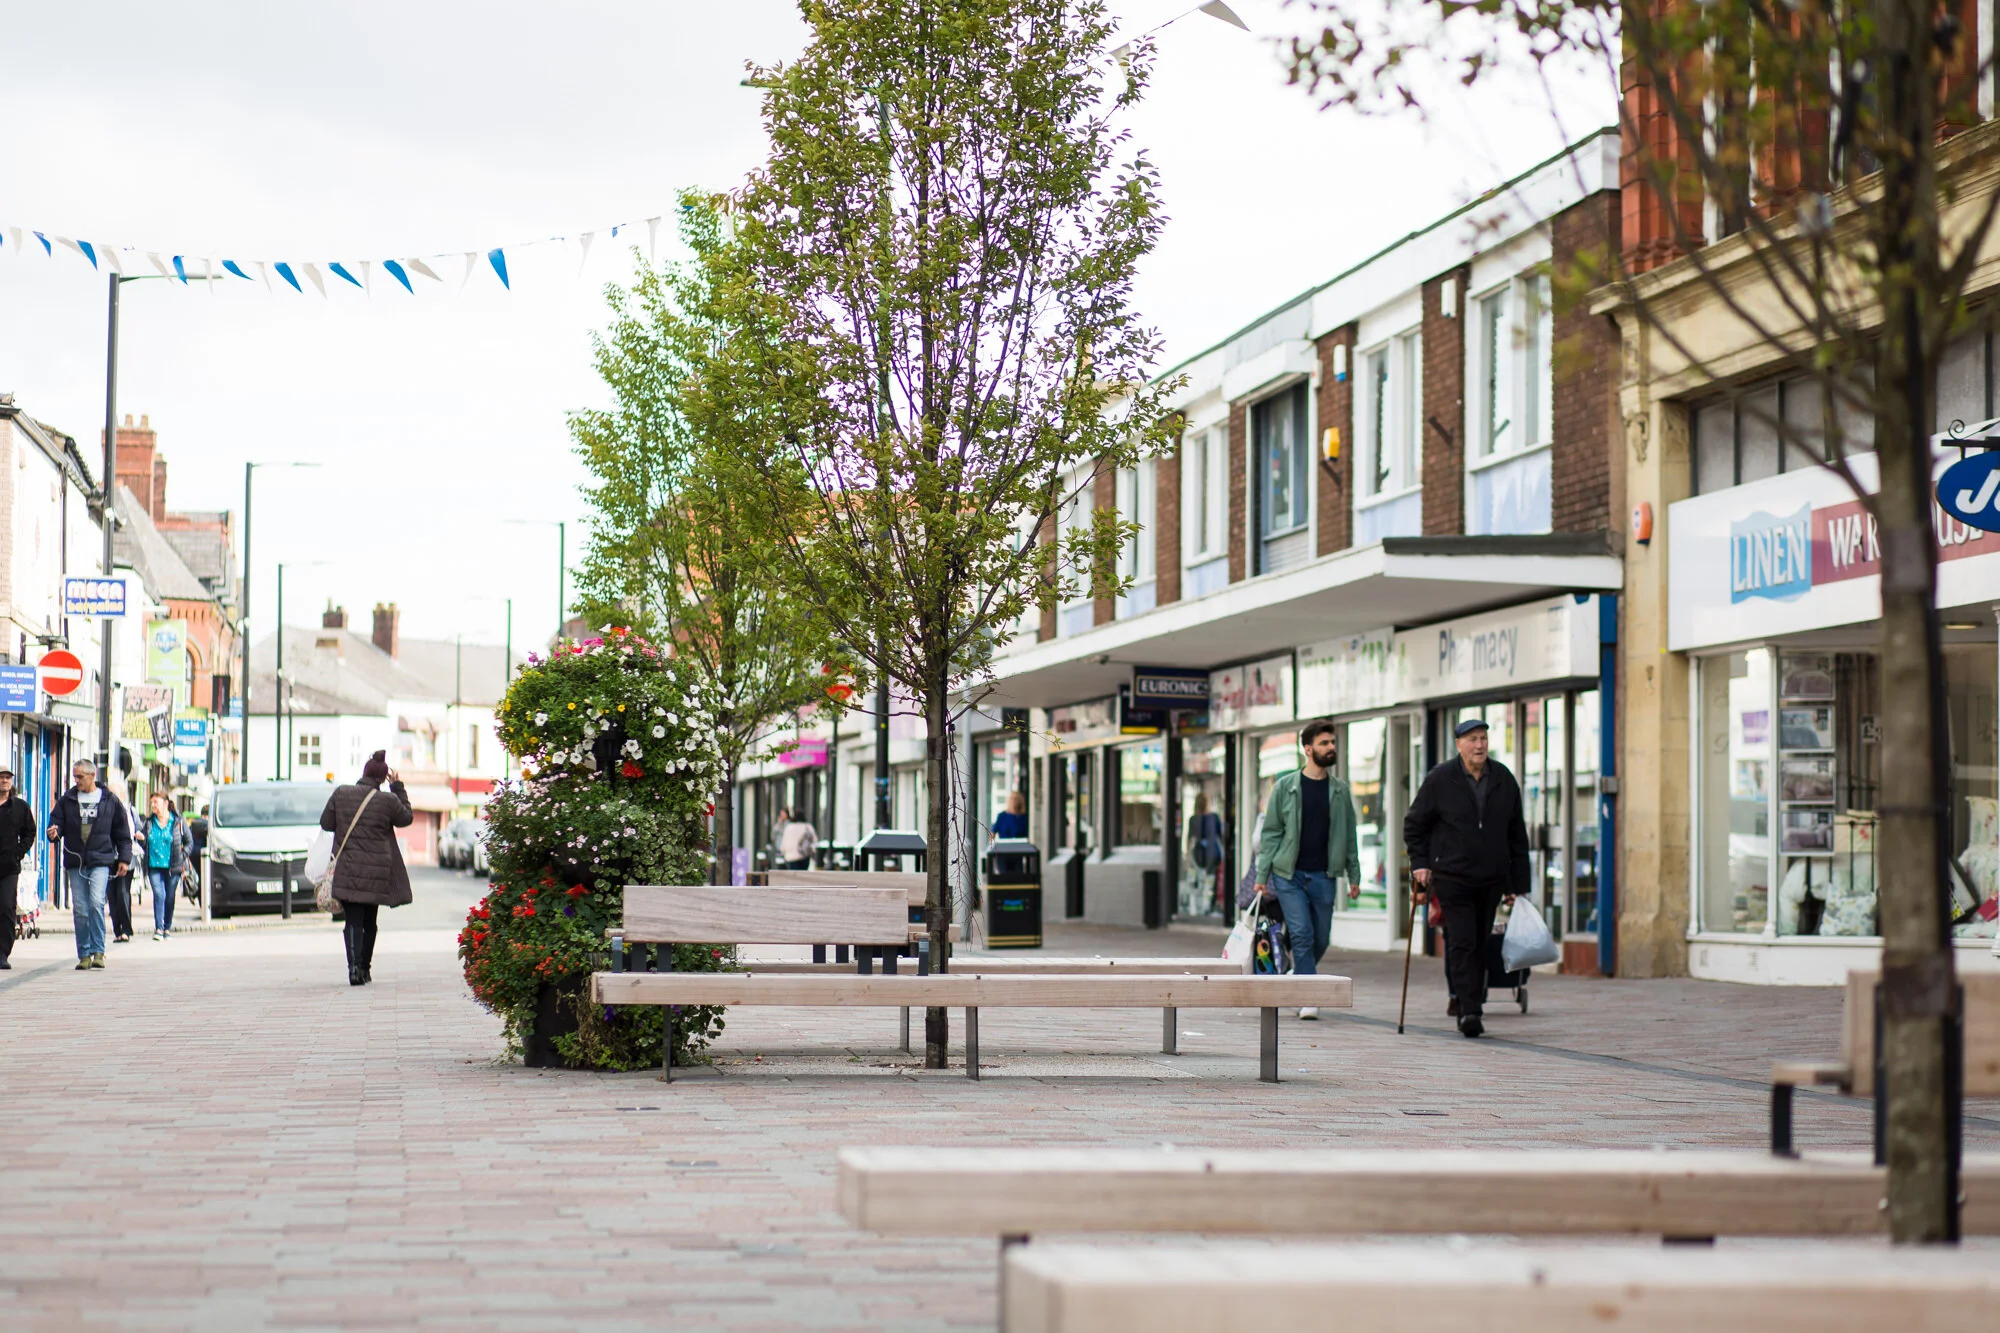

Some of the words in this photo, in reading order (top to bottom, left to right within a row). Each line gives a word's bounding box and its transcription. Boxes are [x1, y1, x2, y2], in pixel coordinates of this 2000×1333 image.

[1955, 468, 2000, 514] J
[1733, 520, 1809, 593] LINEN
[1438, 627, 1518, 678] Phmacy
